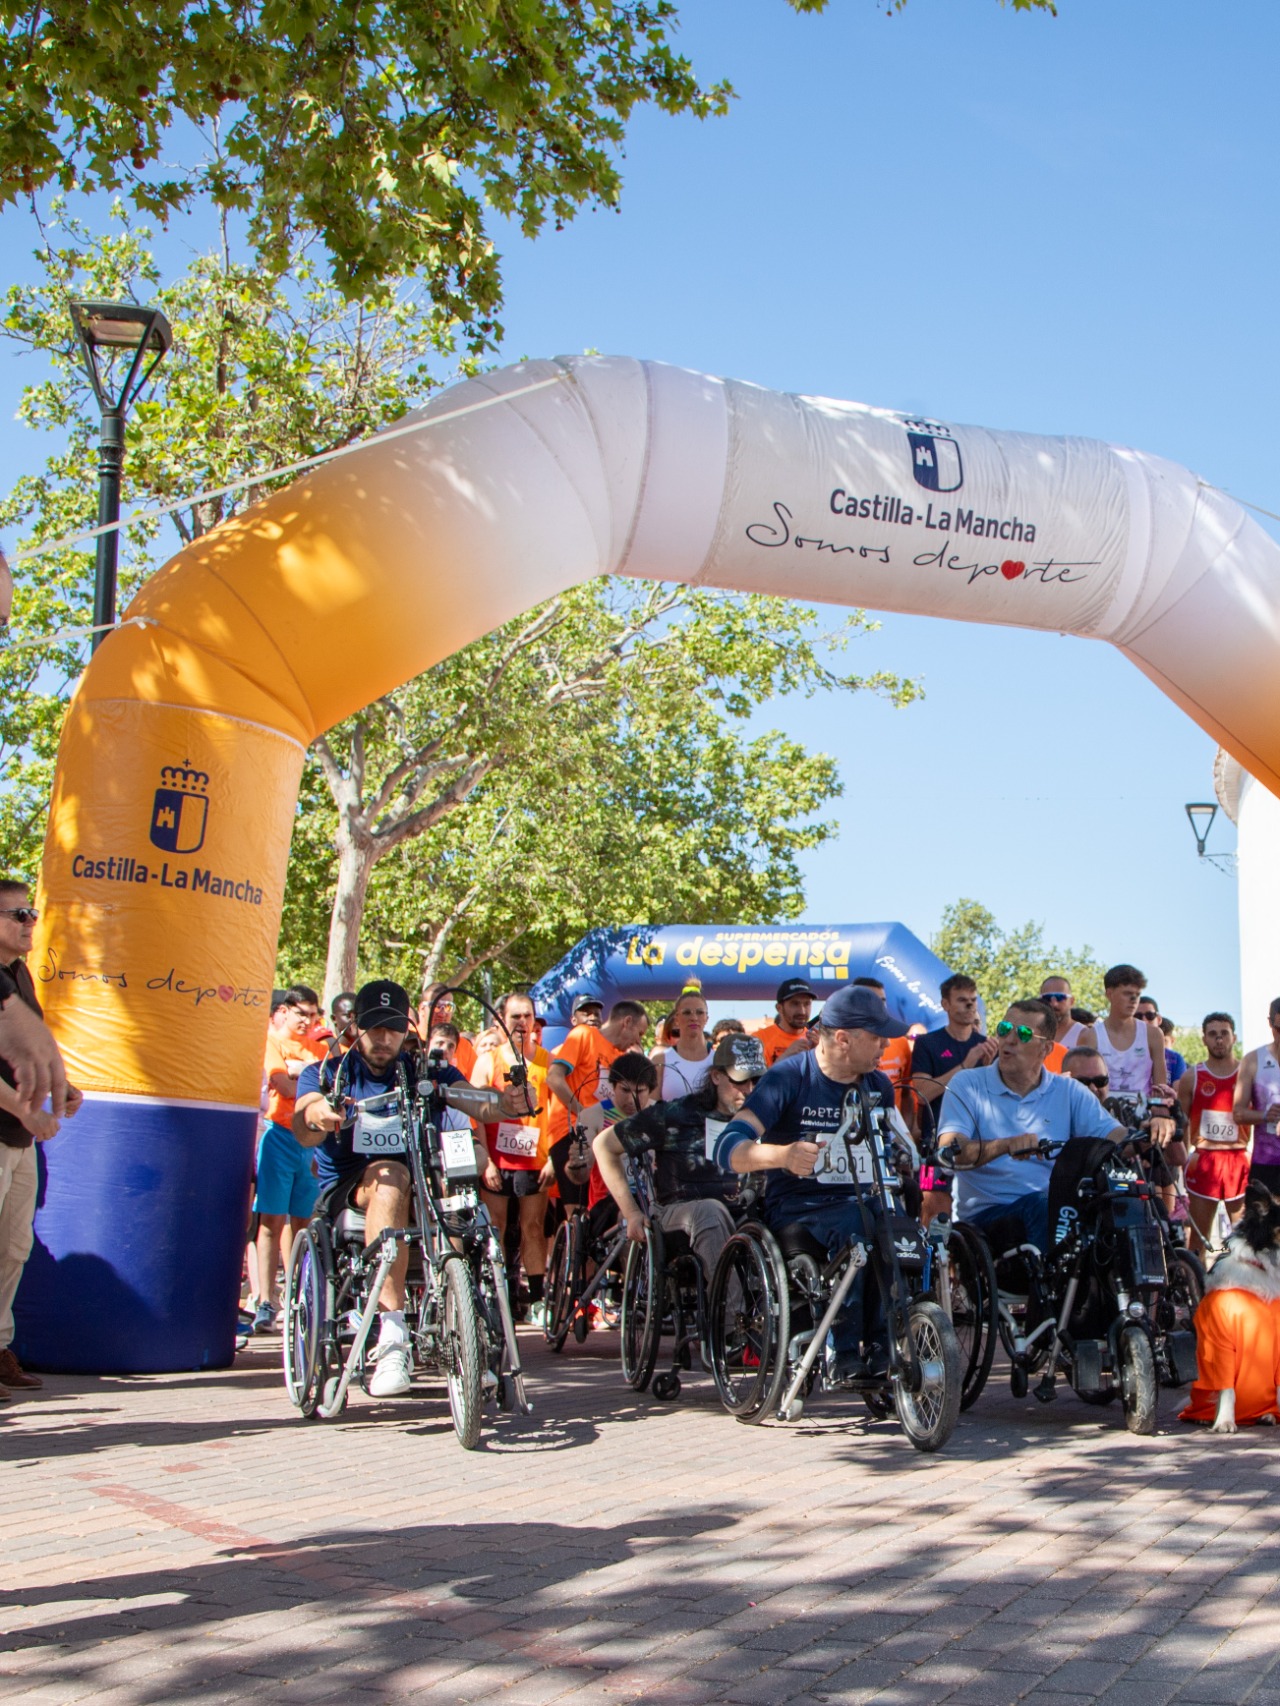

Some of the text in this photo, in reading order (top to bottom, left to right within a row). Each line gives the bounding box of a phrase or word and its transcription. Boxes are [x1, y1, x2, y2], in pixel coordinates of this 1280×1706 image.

[829, 488, 1037, 543] Castilla-La Mancha
[745, 502, 891, 563] Somos
[72, 855, 264, 905] Castilla-La Mancha
[715, 931, 840, 941] SUPERMERCADOS
[38, 947, 128, 988] Somos
[626, 936, 852, 973] La despensa
[380, 992, 391, 1006] S
[361, 1131, 404, 1146] 300
[1206, 1124, 1234, 1136] 1078
[503, 1137, 533, 1151] 1050
